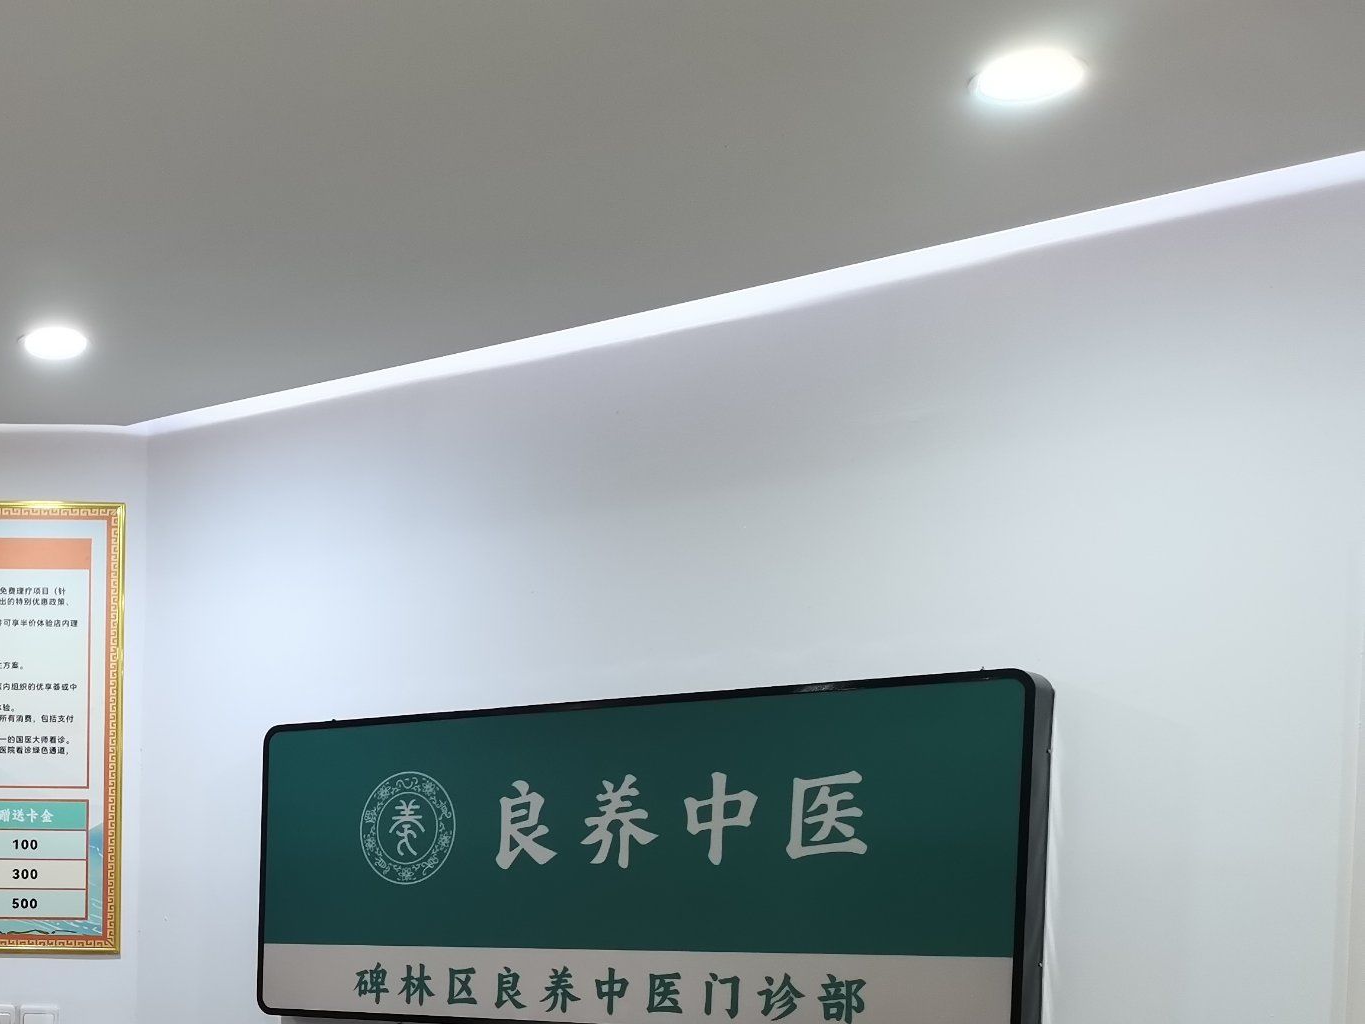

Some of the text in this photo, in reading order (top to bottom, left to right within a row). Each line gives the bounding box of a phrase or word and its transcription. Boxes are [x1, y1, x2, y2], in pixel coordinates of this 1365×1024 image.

[494, 769, 870, 870] 良养中医
[13, 840, 37, 850] 100
[12, 869, 37, 879] 300
[12, 898, 37, 909] 500
